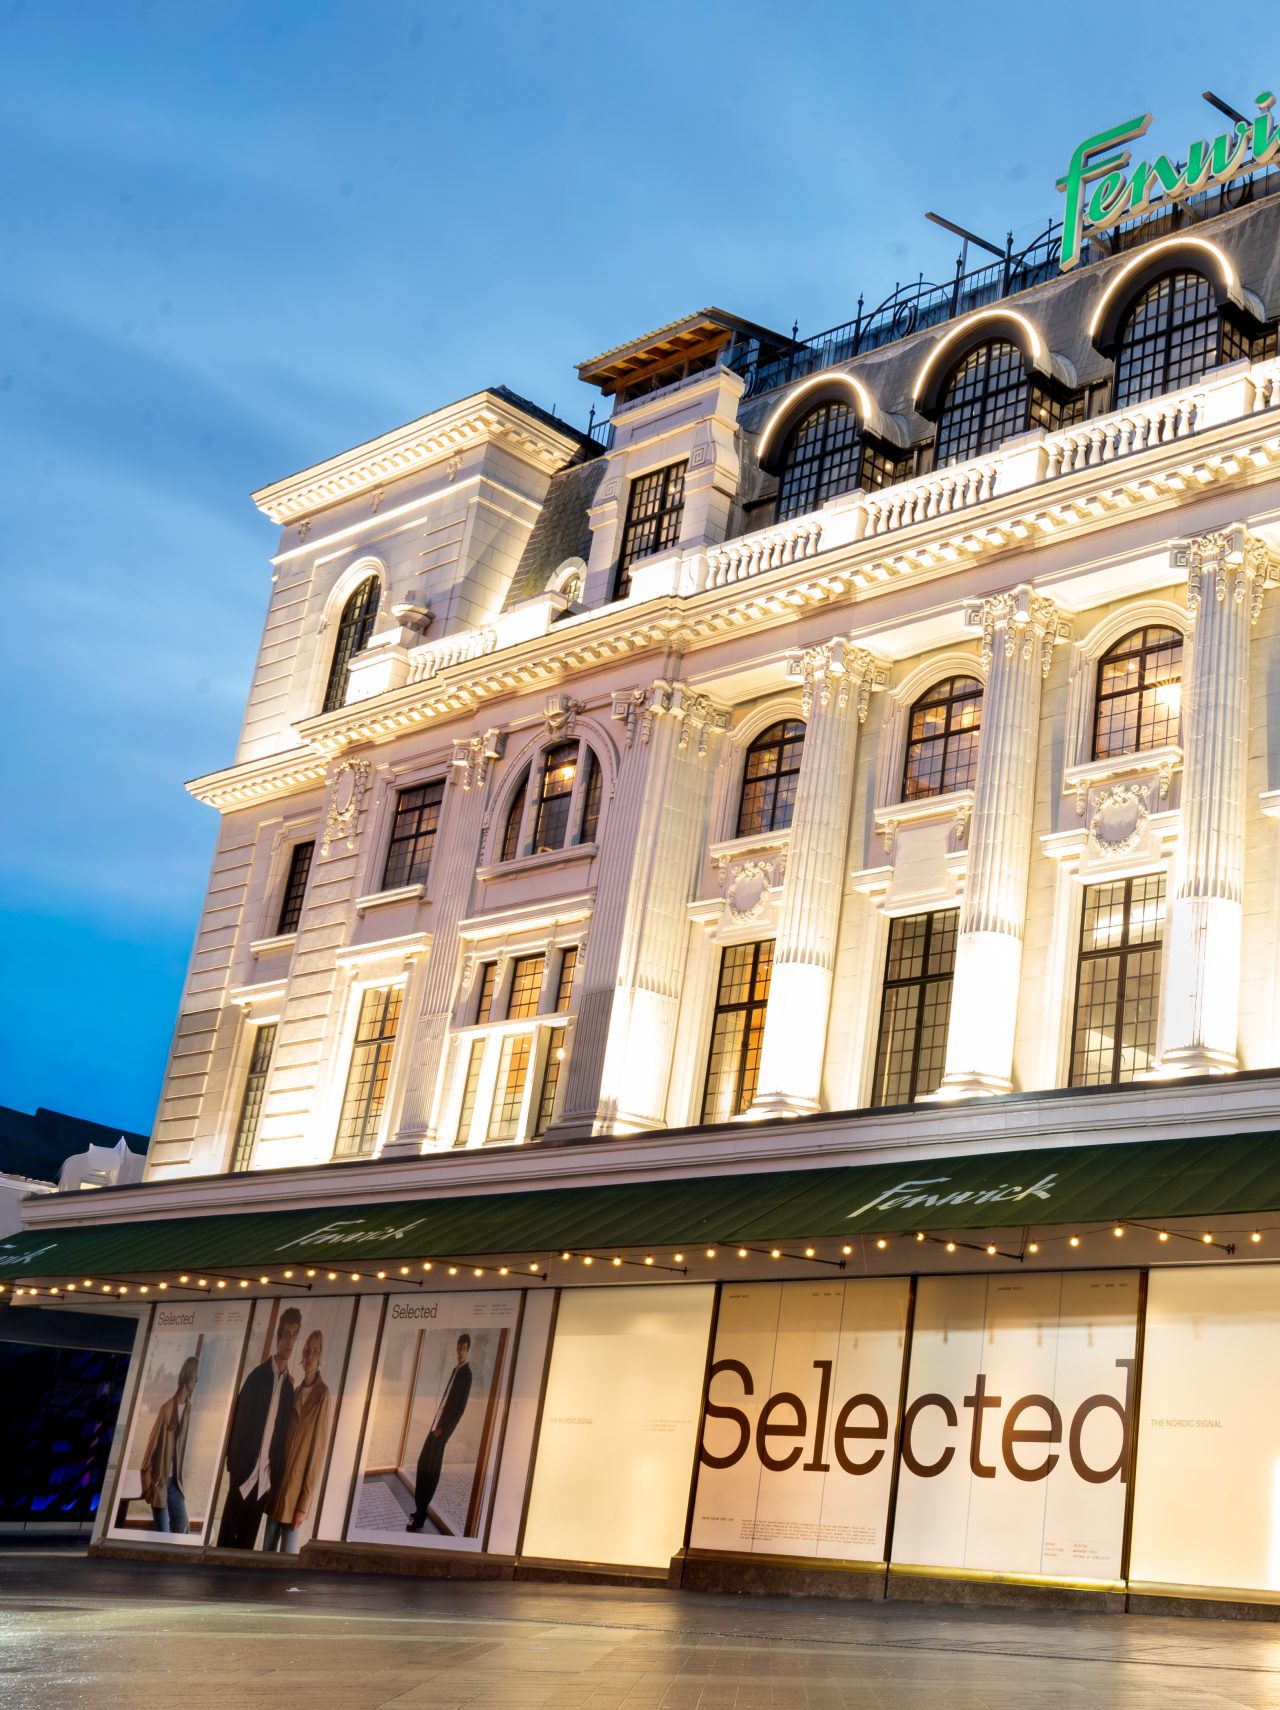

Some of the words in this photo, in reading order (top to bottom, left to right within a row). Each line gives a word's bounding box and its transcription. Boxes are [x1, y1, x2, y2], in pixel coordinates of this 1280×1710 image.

[846, 1173, 1058, 1218] Fenwick
[157, 1311, 196, 1326] Selected
[391, 1303, 439, 1319] Selected
[699, 1358, 1135, 1484] Selected
[1150, 1418, 1165, 1427] THE
[1166, 1418, 1195, 1428] NORDIC
[1195, 1418, 1223, 1428] SIGNAL
